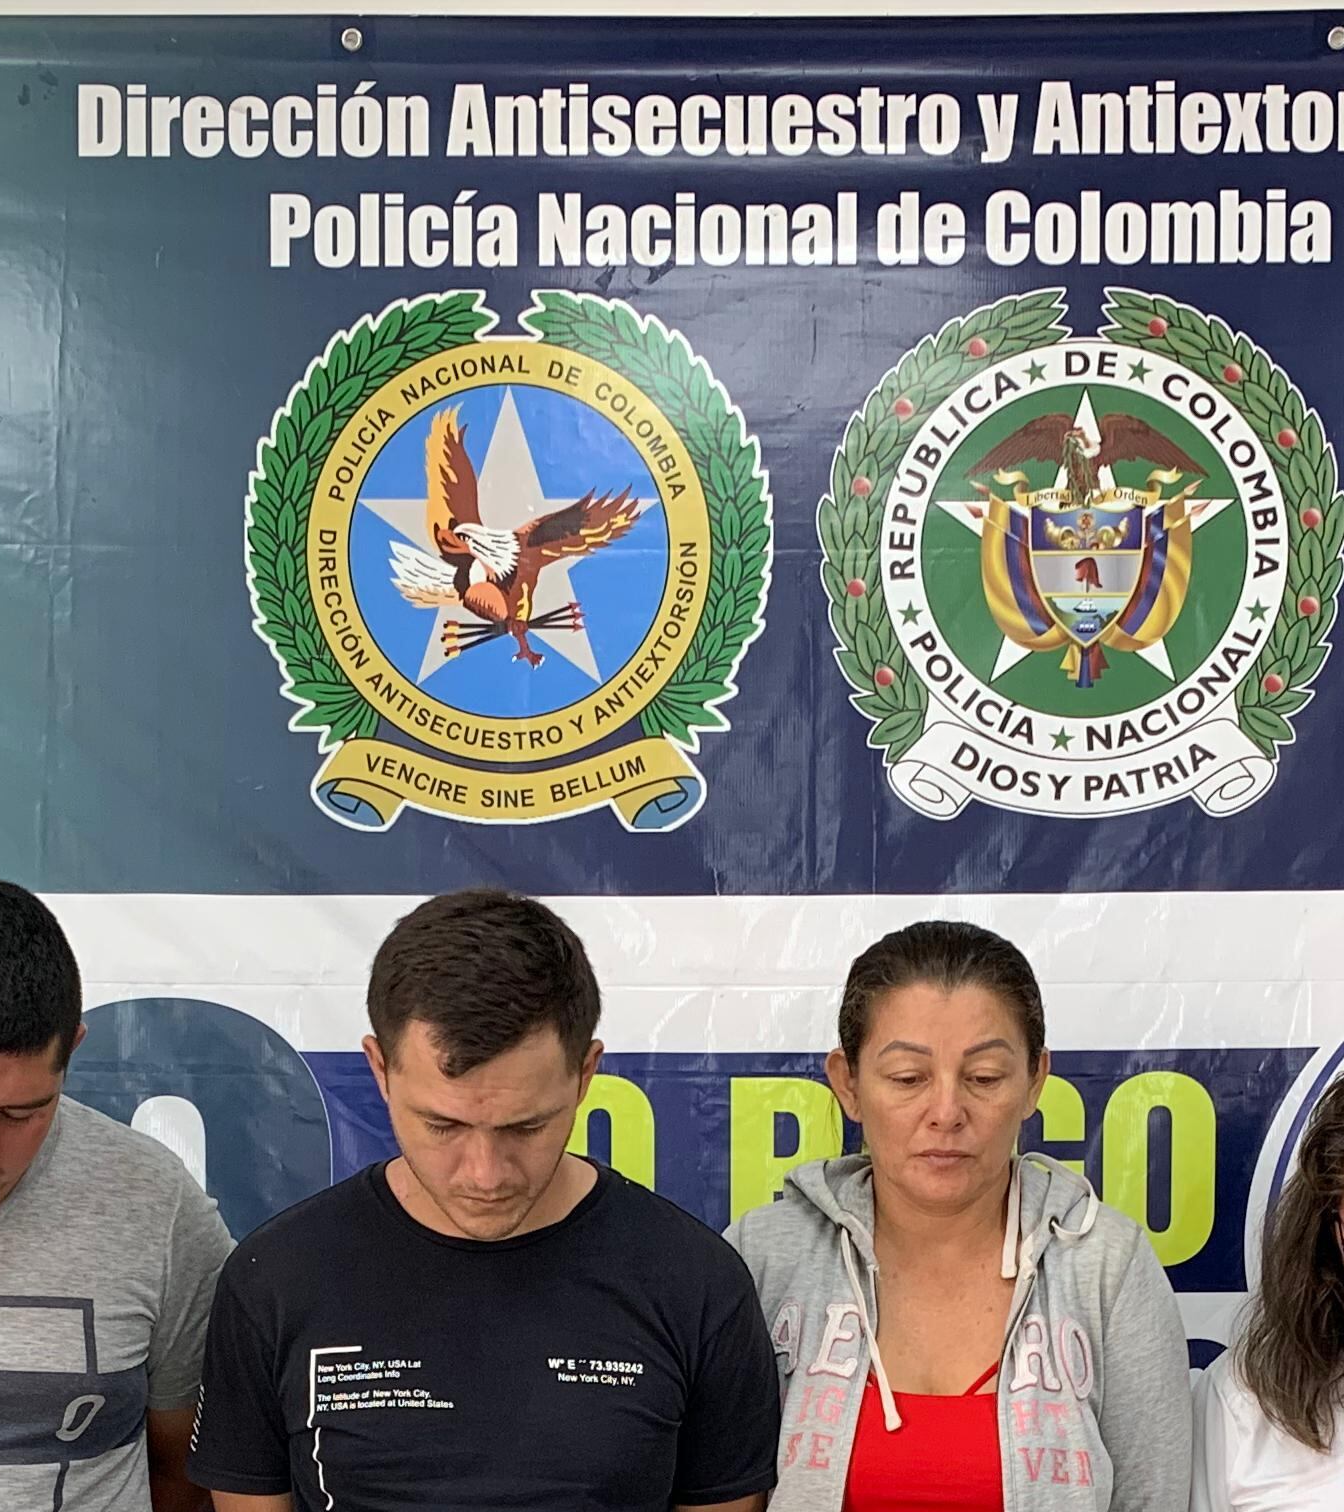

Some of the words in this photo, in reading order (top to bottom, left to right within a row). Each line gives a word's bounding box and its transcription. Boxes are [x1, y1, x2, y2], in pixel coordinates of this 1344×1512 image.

[78, 82, 430, 158] Dirección
[446, 82, 961, 157] Antisecuestro
[977, 95, 1019, 164] y
[270, 190, 518, 268] Policía
[538, 192, 858, 267] Nacional
[867, 192, 966, 267] de
[985, 189, 1332, 266] Colombia
[329, 405, 396, 503] POLICÍA
[399, 353, 531, 406] NACIONAL
[547, 359, 582, 387] DE
[594, 381, 687, 502] COLOMBIA
[889, 370, 1022, 581] REPÚBLICA
[1064, 350, 1119, 379] DE
[1161, 372, 1280, 580] COLOMBIA
[317, 528, 371, 670] DIRECCIÓN
[365, 670, 565, 751] ANTISECUESTRO
[568, 715, 587, 737] Y
[593, 541, 698, 729] ANTIEXTORSIÓN
[908, 631, 1036, 746] POLICÍA
[1085, 627, 1263, 752] NACIONAL
[364, 752, 468, 805] VENCIRE
[480, 788, 536, 809] SINE
[550, 755, 647, 803] BELLUM
[949, 741, 1042, 799] DIOS
[1048, 775, 1073, 800] Y
[1083, 742, 1218, 801] PATRIA
[317, 1364, 335, 1374] New
[335, 1363, 353, 1373] York
[387, 1360, 407, 1369] USA
[407, 1359, 422, 1369] Lat
[317, 1374, 337, 1384] Long
[317, 1393, 332, 1402] The
[361, 1390, 370, 1400] of
[372, 1389, 392, 1399] New
[392, 1389, 412, 1398] York
[557, 1371, 579, 1382] New
[579, 1373, 599, 1384] York
[589, 1360, 644, 1375] 73.935242
[330, 1401, 349, 1411] USA
[357, 1399, 386, 1410] located
[387, 1399, 396, 1408] at
[397, 1399, 425, 1409] United
[426, 1399, 455, 1409] States
